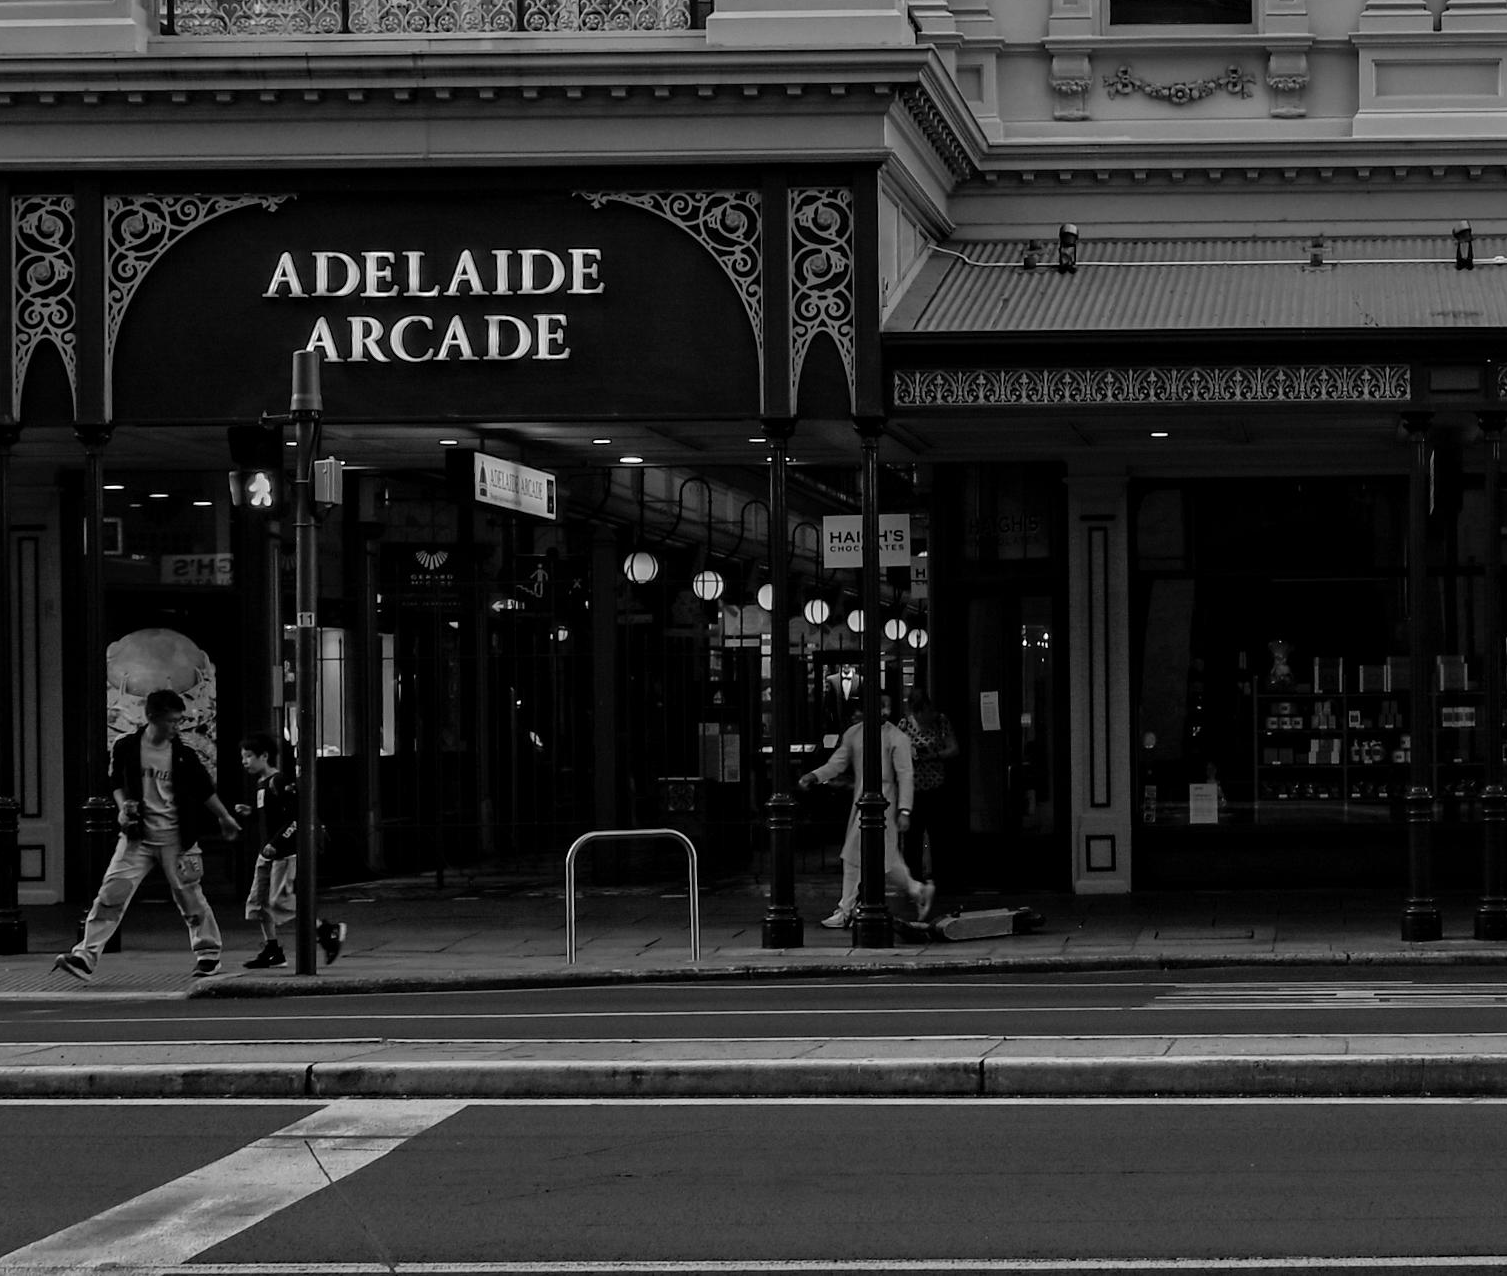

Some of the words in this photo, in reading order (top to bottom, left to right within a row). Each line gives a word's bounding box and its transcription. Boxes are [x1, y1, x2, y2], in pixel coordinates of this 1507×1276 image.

[261, 248, 606, 298] ADELAIDE
[304, 313, 572, 364] ARCADE
[970, 513, 1039, 536] HAGH'S
[829, 530, 904, 544] HAIH'S
[829, 545, 904, 553] CHOCATES
[298, 614, 313, 625] 11
